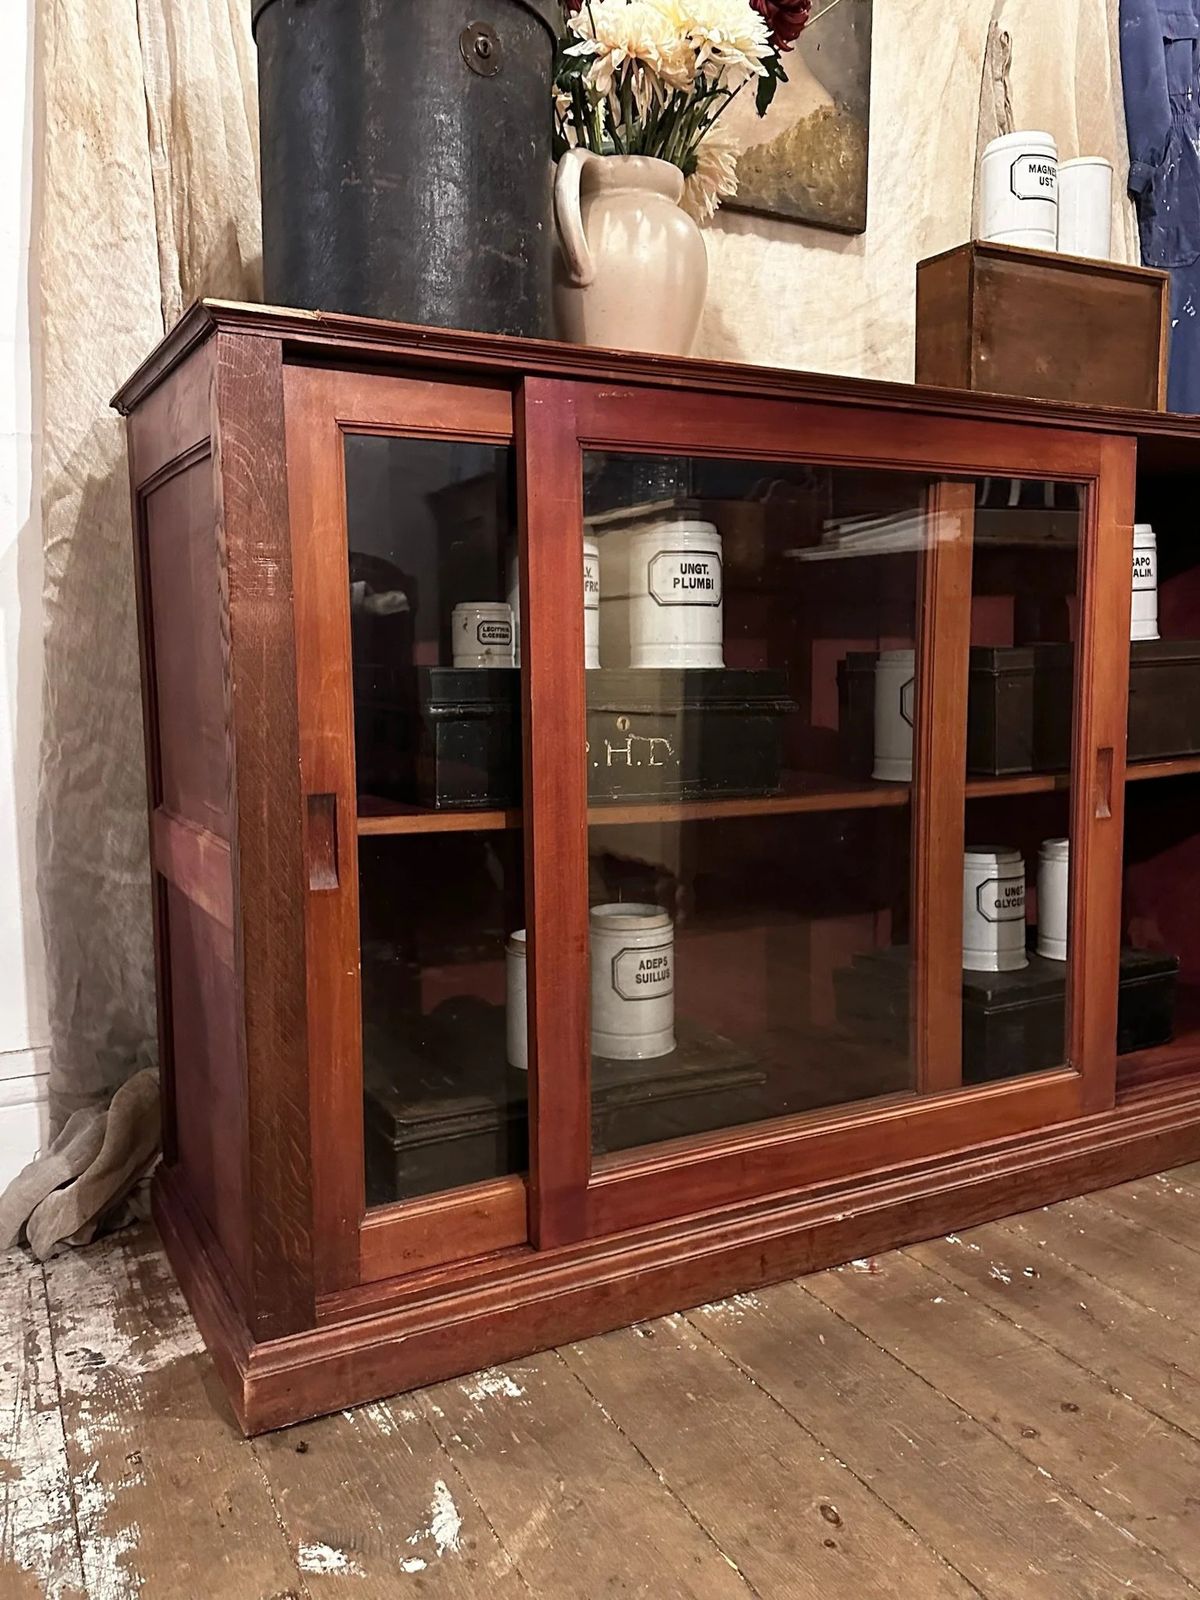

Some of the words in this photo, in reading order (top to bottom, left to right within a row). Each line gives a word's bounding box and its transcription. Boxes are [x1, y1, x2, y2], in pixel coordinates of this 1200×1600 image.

[680, 563, 709, 575] UNGT.
[673, 577, 714, 590] PLUMBI
[638, 956, 668, 971] ADEPS
[635, 968, 670, 984] SUILLUS
